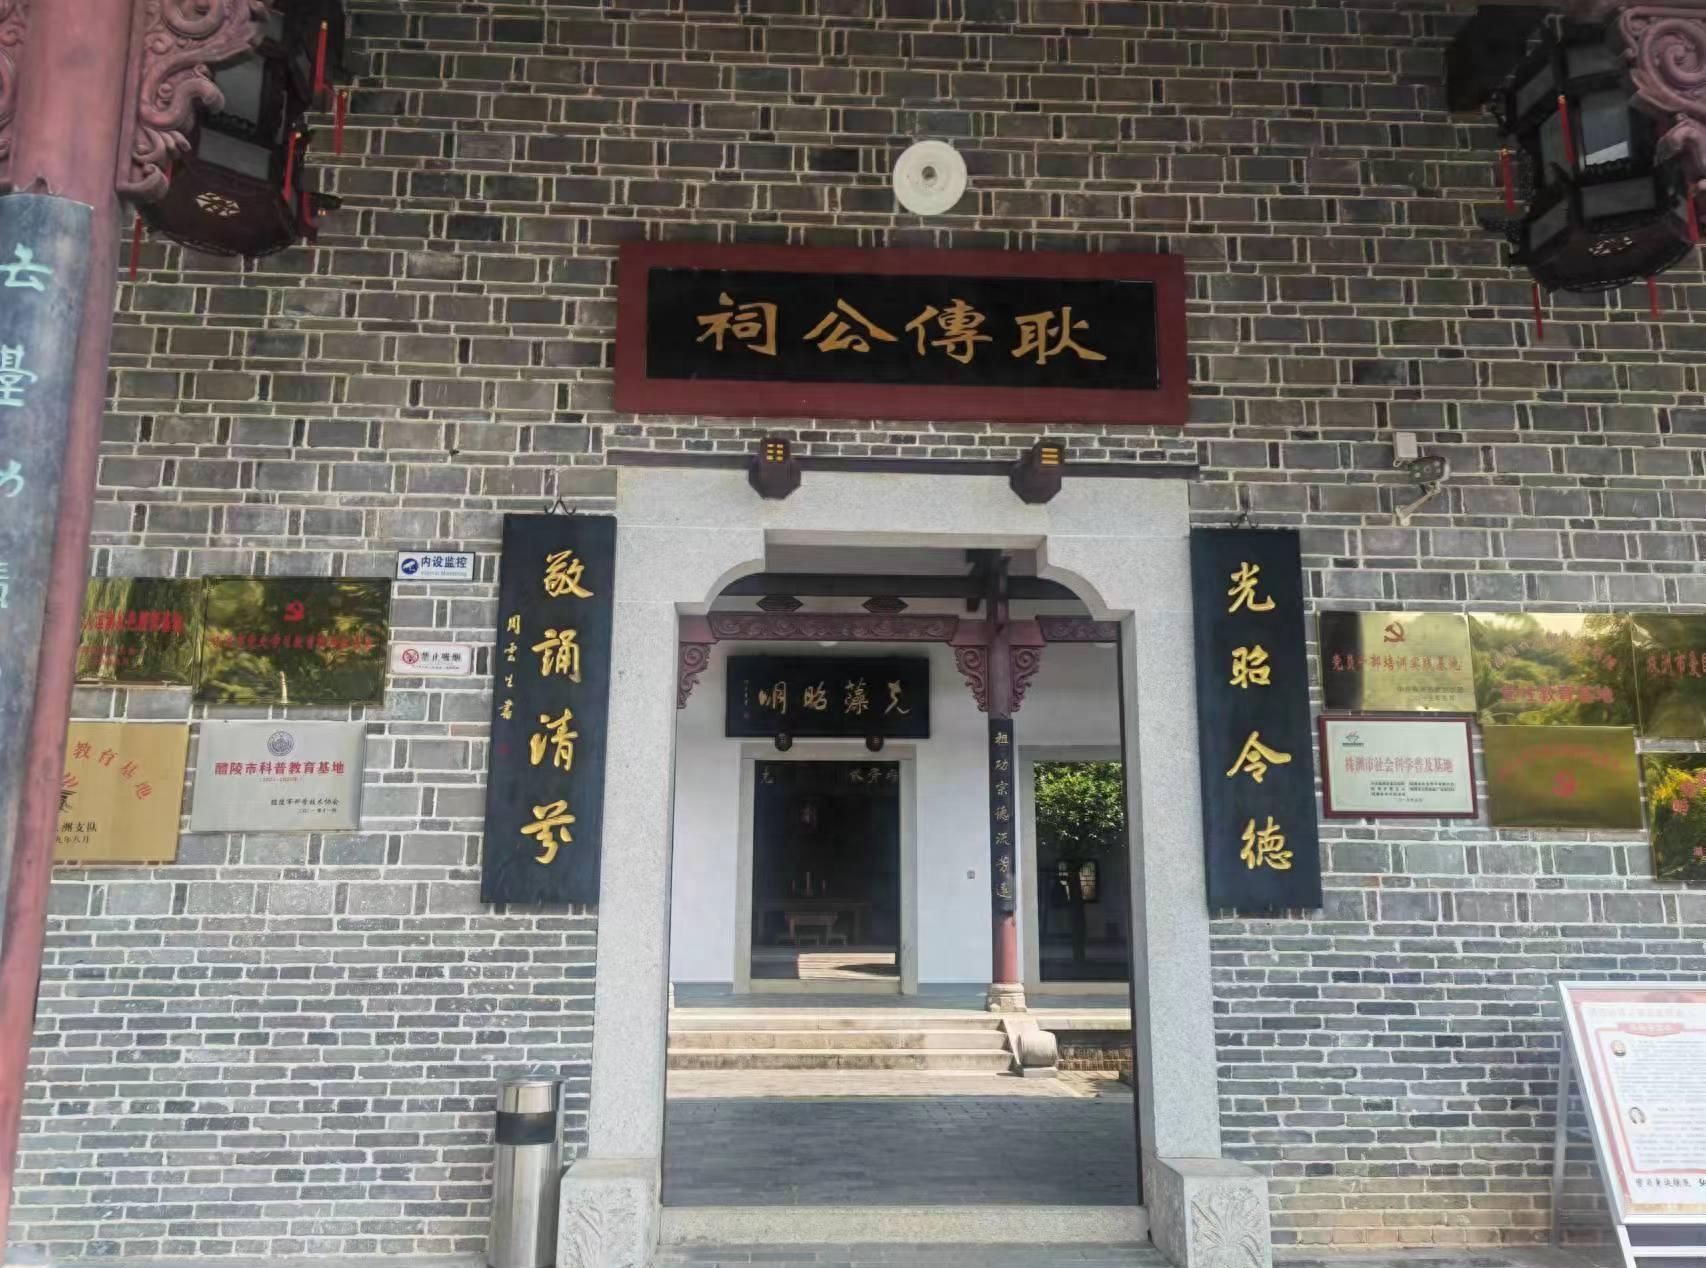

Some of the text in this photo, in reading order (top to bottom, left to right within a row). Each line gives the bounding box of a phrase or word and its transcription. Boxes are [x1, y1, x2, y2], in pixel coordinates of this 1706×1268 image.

[696, 292, 1107, 365] 耿傳公祠
[420, 555, 468, 569] 内设监控
[421, 651, 462, 662] 禁止吸烟
[1332, 653, 1463, 672] 党员干部培训实践基地
[1226, 561, 1294, 870] 光昭令德
[72, 740, 153, 800] 教育基地
[214, 761, 345, 775] 醴陵市科普教育基地
[1345, 755, 1454, 773] 株洲市社会科学普及基地
[56, 821, 97, 832] 洲支队
